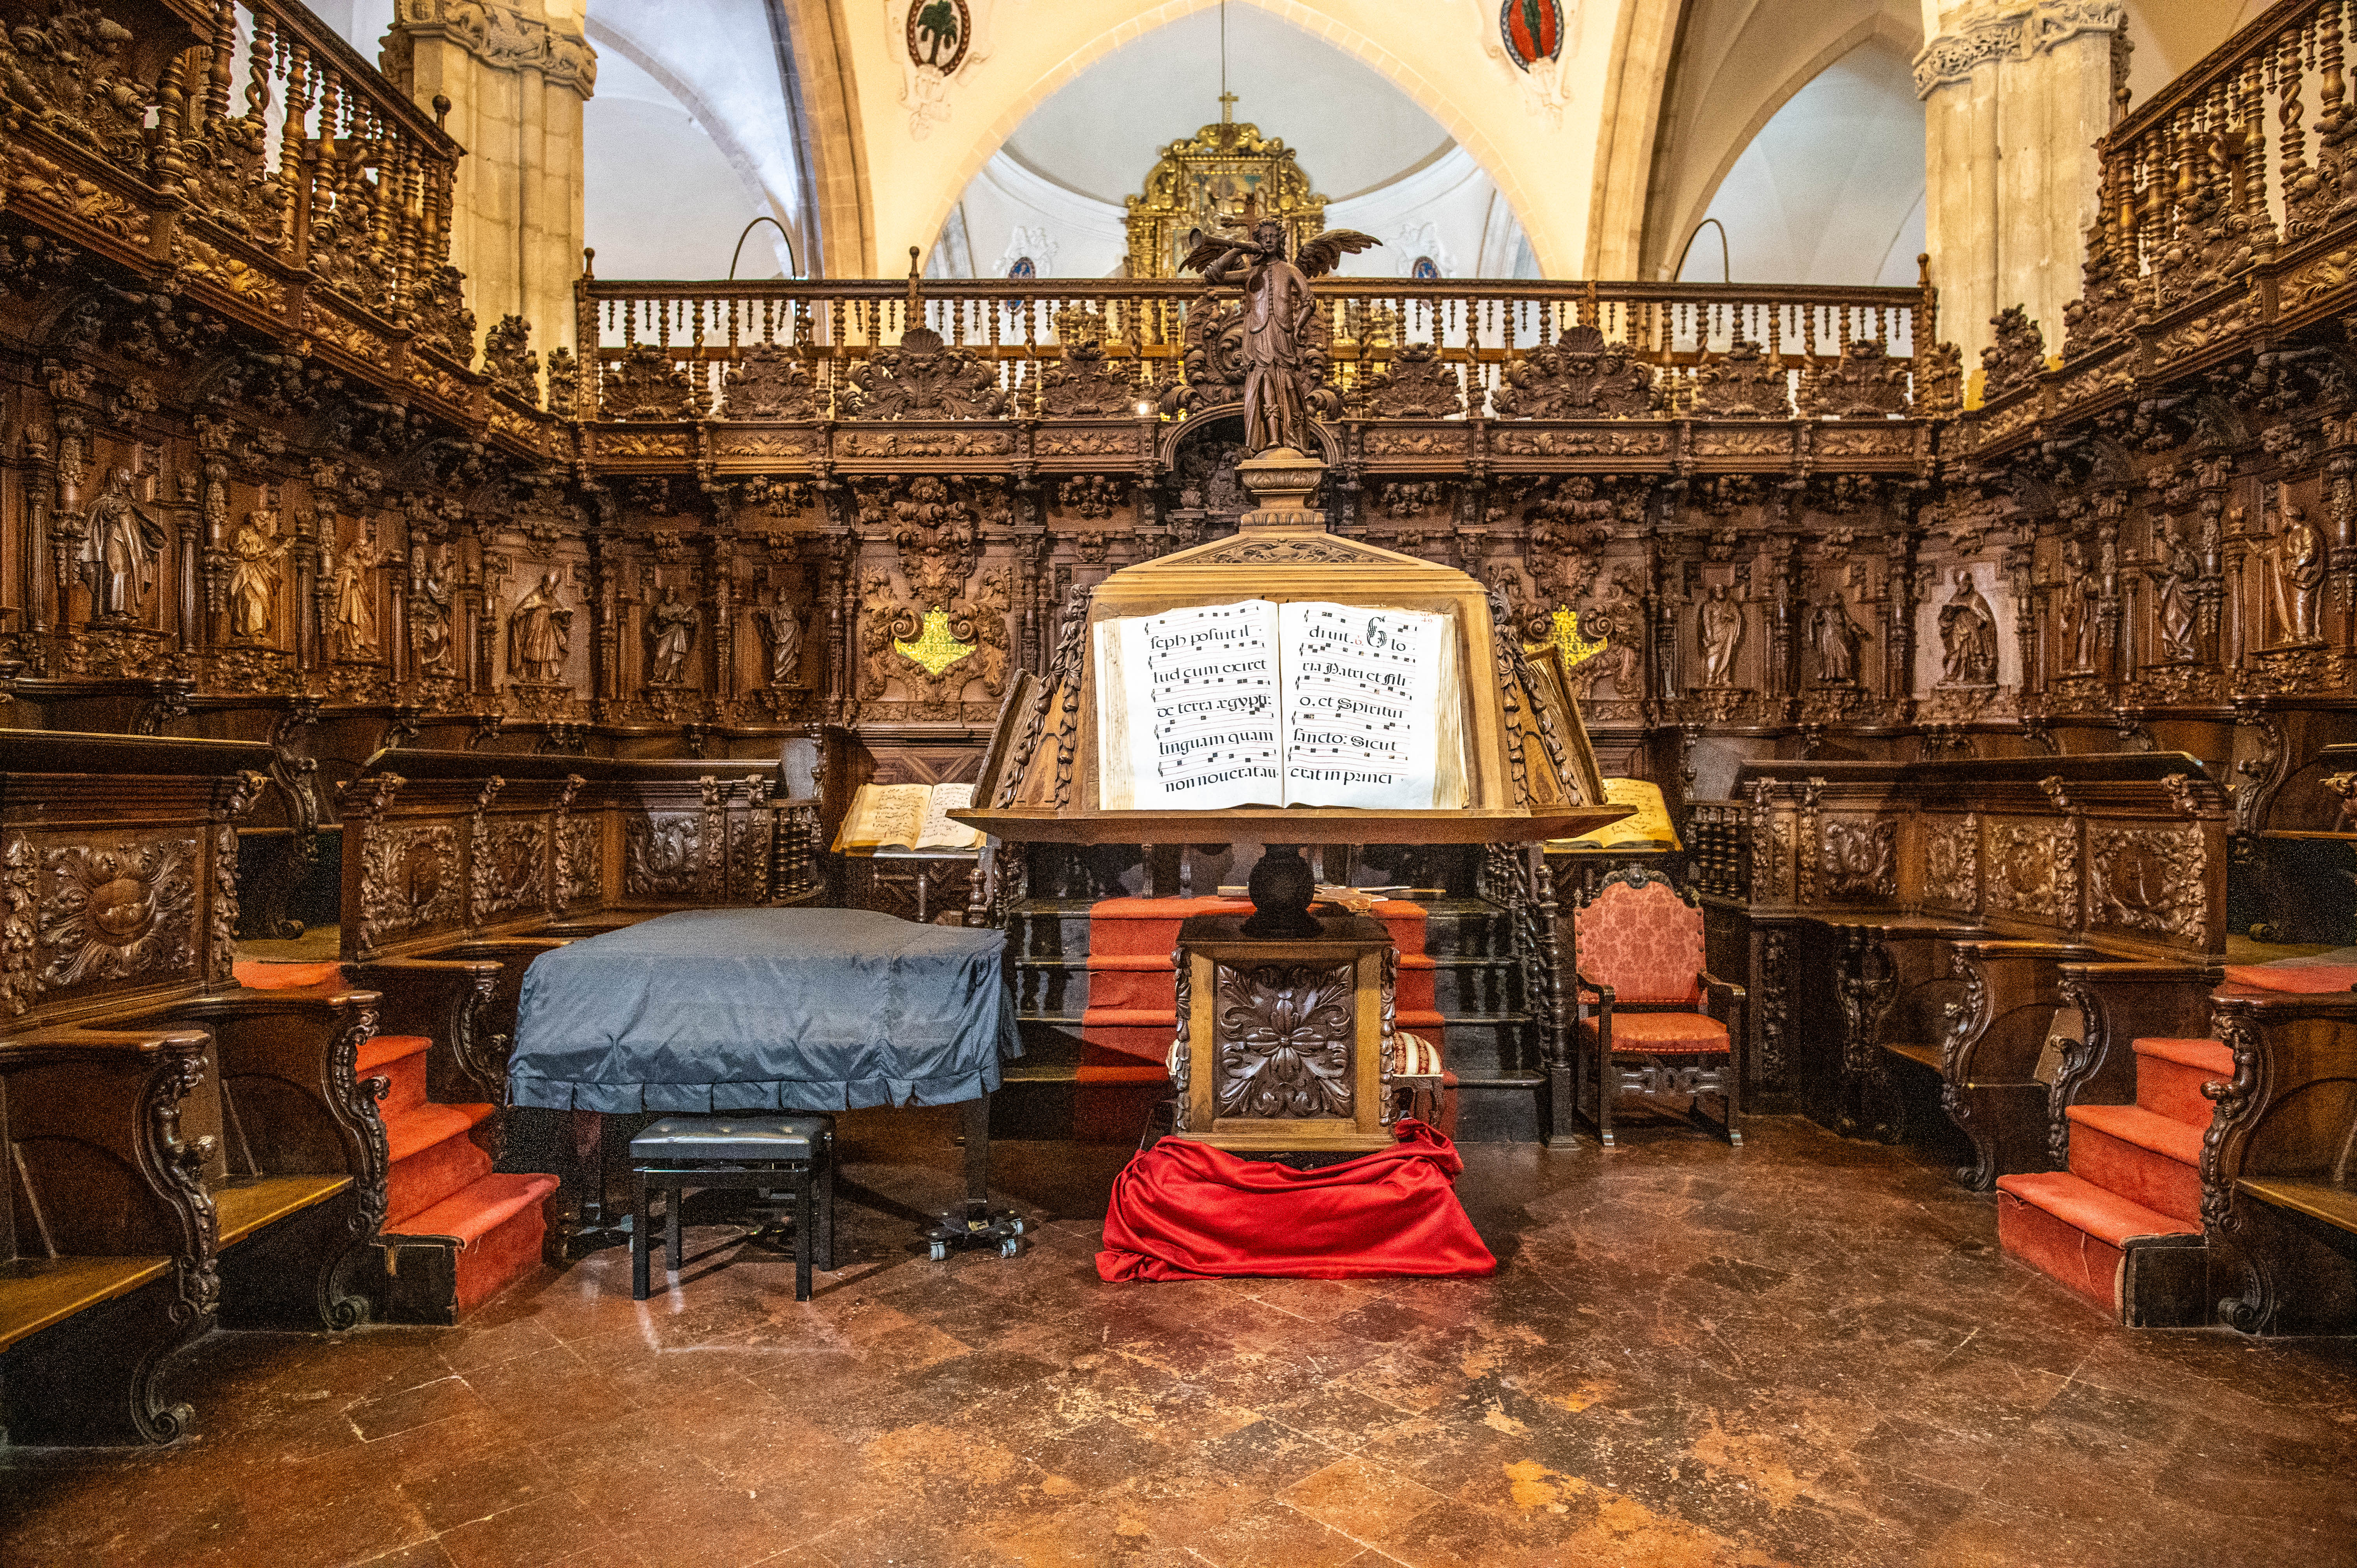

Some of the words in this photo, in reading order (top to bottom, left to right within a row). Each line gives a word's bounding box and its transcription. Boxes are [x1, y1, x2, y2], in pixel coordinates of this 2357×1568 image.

[1154, 667, 1180, 683] lud
[1184, 666, 1218, 677] cum
[1302, 662, 1321, 671] ria
[1323, 663, 1363, 679] Patri
[1366, 673, 1382, 683] et
[1157, 707, 1174, 717] de
[1178, 701, 1212, 713] terra
[1318, 697, 1334, 707] et
[1160, 735, 1224, 755] linguam
[1228, 732, 1273, 744] quam
[1351, 736, 1396, 751] Sicut
[1290, 768, 1322, 780] erat
[1325, 771, 1340, 780] in
[1166, 779, 1194, 792] non
